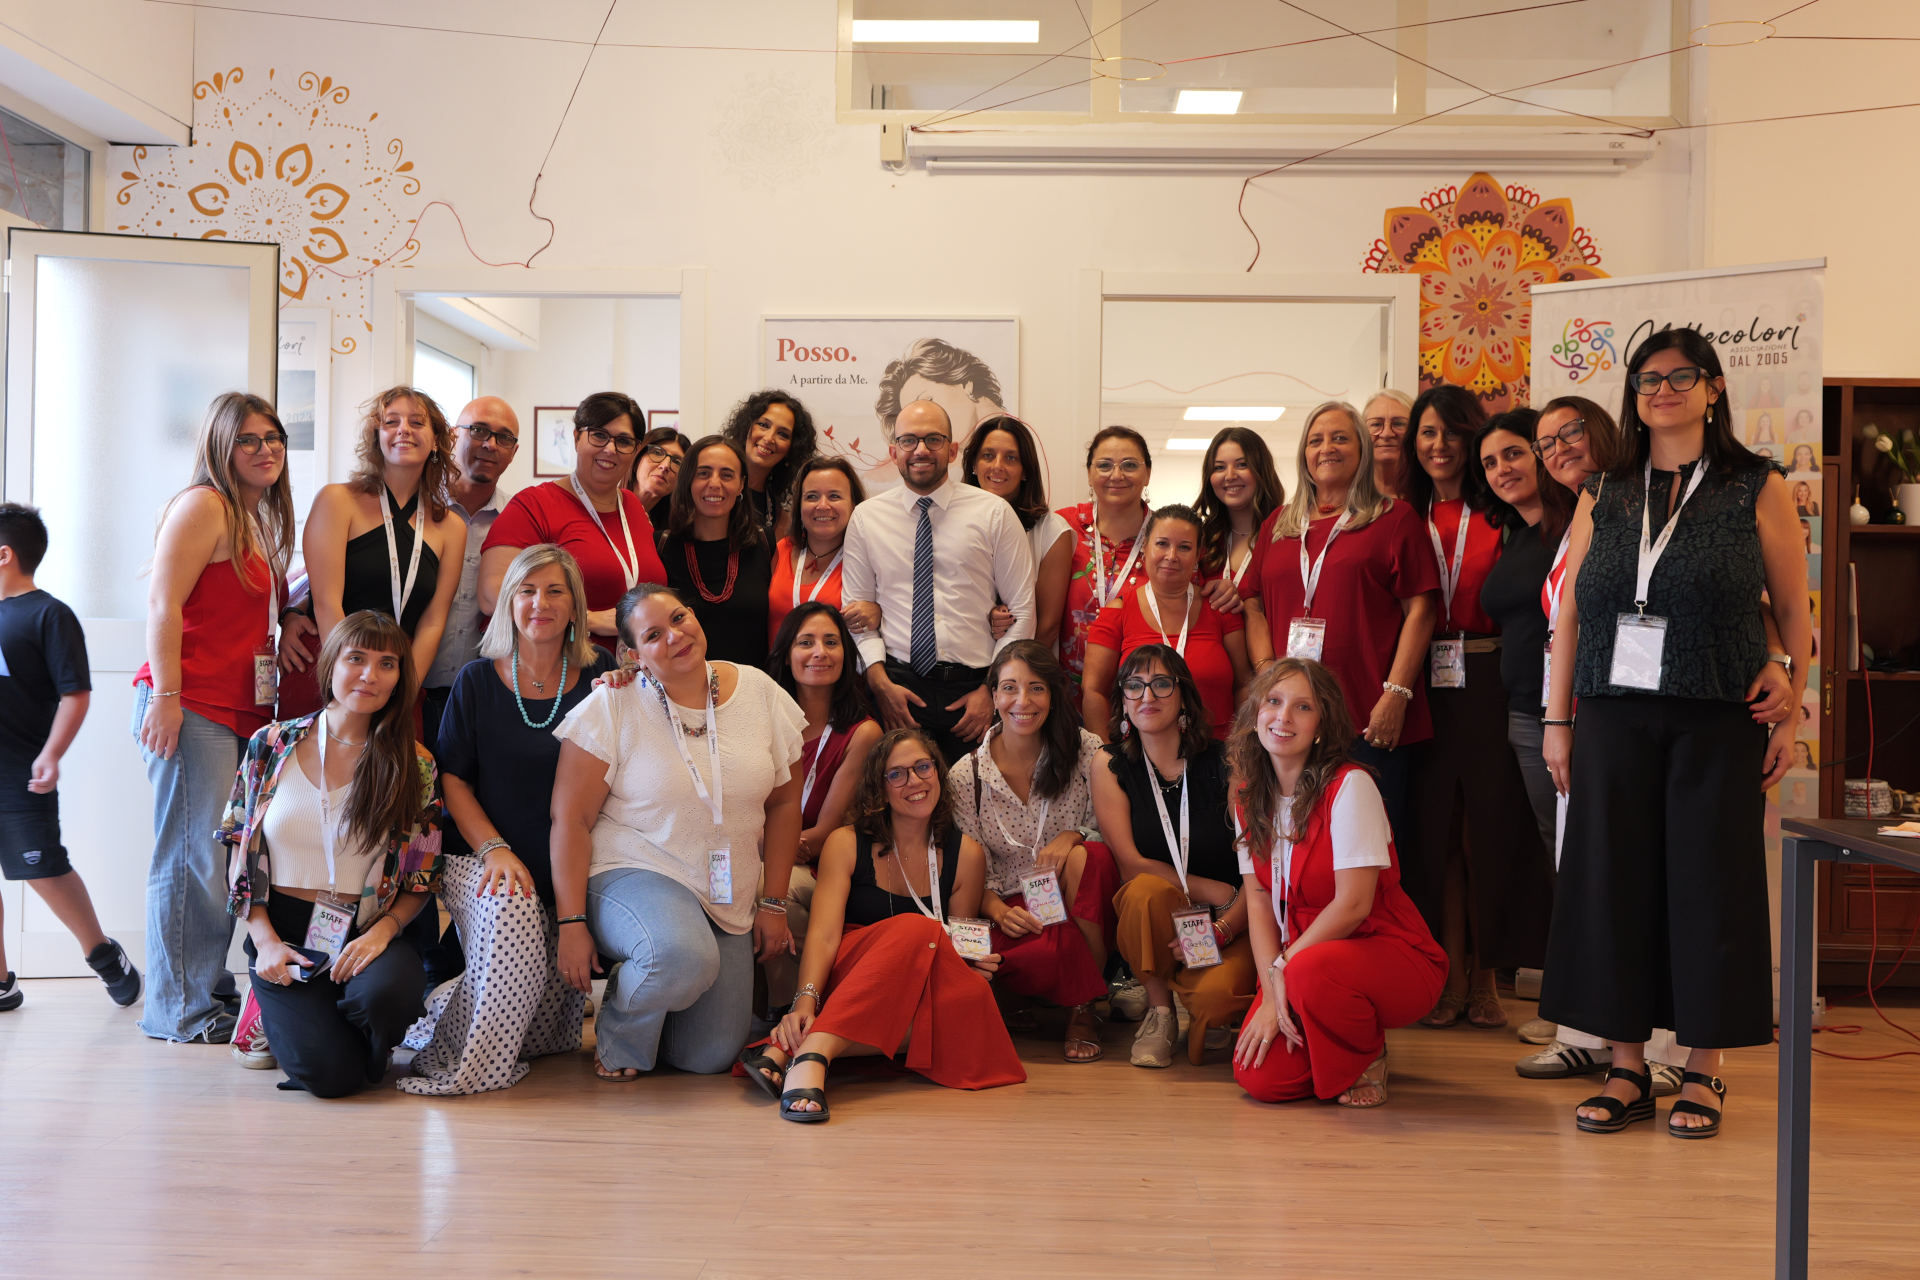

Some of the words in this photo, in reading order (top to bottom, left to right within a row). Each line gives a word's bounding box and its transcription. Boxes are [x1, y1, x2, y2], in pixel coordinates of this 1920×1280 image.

[776, 338, 857, 362] Posso.
[1729, 355, 1751, 368] DAL
[1757, 352, 1788, 367] 2005
[789, 373, 798, 385] A
[800, 374, 833, 388] partire
[835, 373, 847, 385] da
[849, 374, 868, 385] Me.
[711, 854, 726, 862] STAFF
[1029, 877, 1050, 889] STAFF
[320, 911, 343, 924] STAFF
[1182, 919, 1204, 929] STAFF
